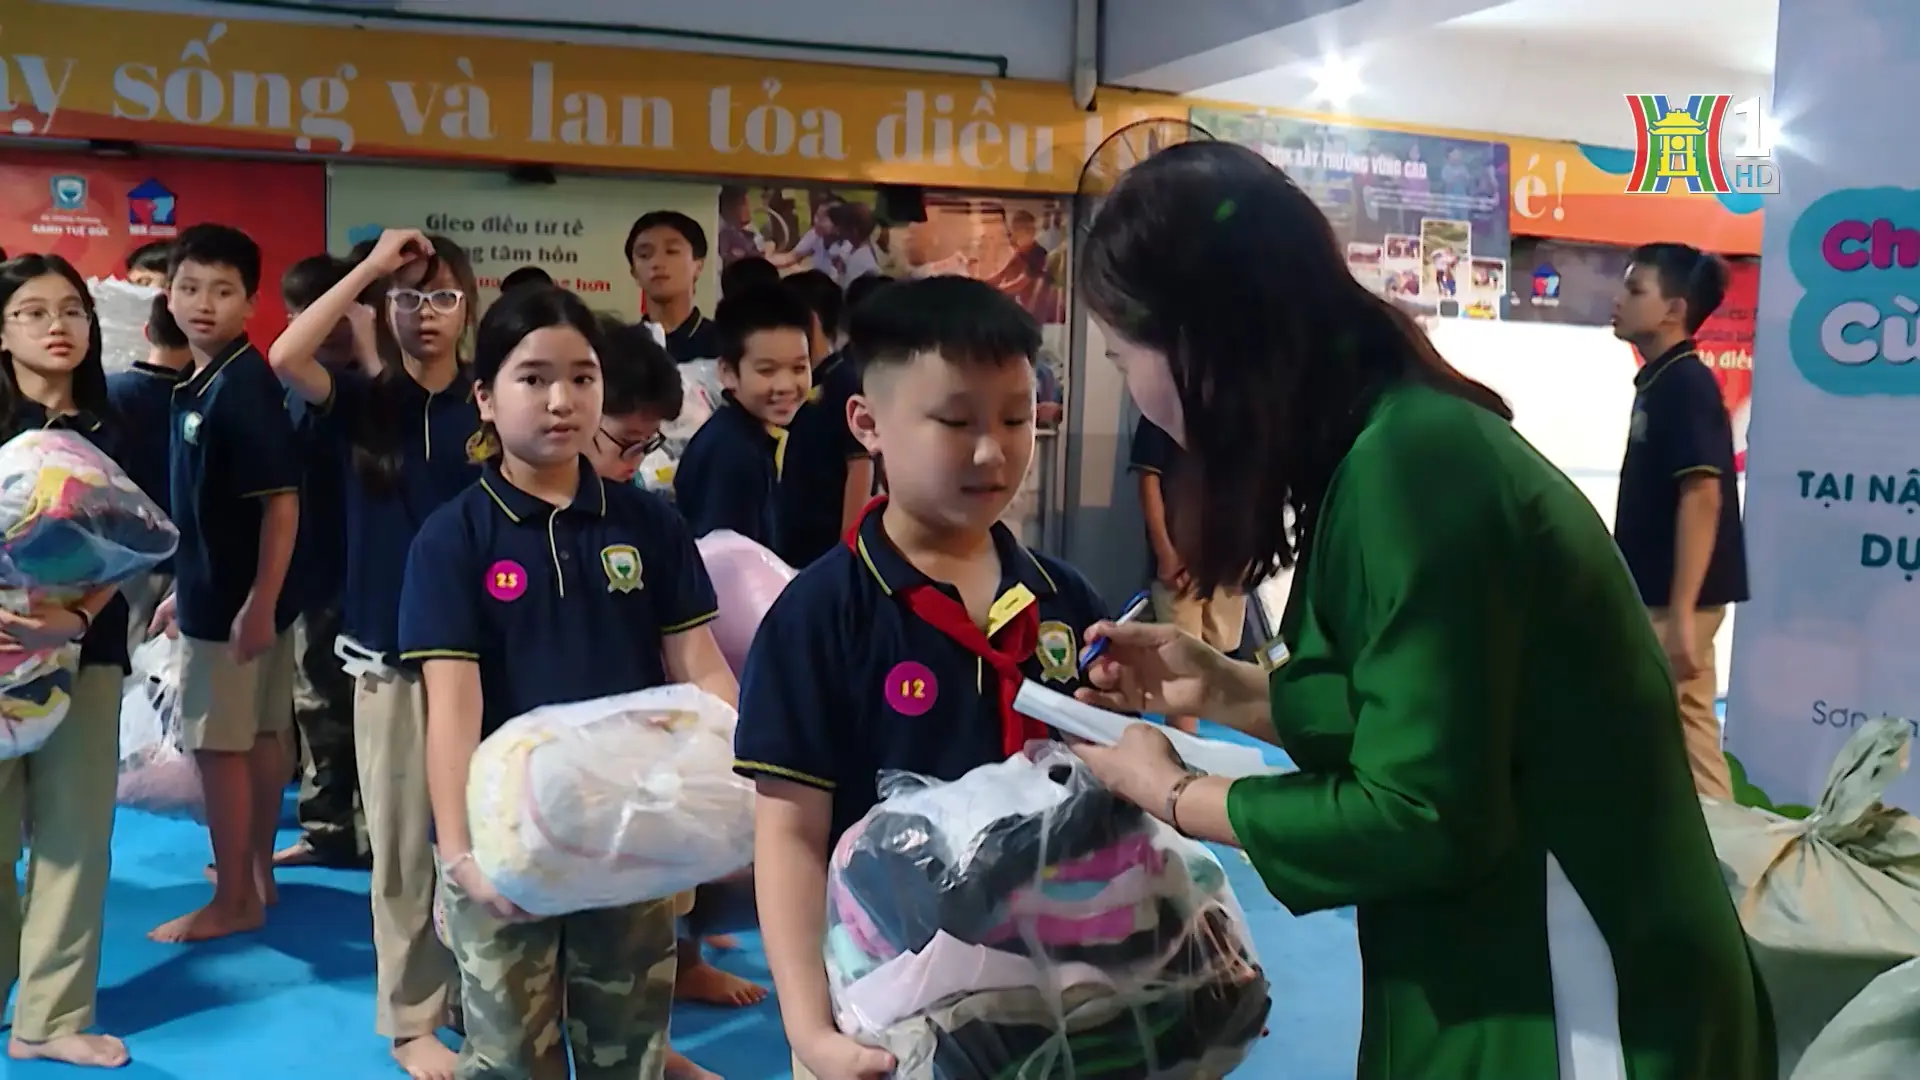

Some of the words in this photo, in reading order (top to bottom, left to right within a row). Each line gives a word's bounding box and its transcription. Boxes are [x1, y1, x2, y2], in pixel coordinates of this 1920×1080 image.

[111, 22, 358, 152] sống
[386, 56, 496, 141] và
[527, 61, 675, 151] lan
[709, 77, 848, 160] tỏa
[1797, 470, 1854, 509] TẠI
[495, 571, 519, 589] 25
[902, 678, 926, 698] 12
